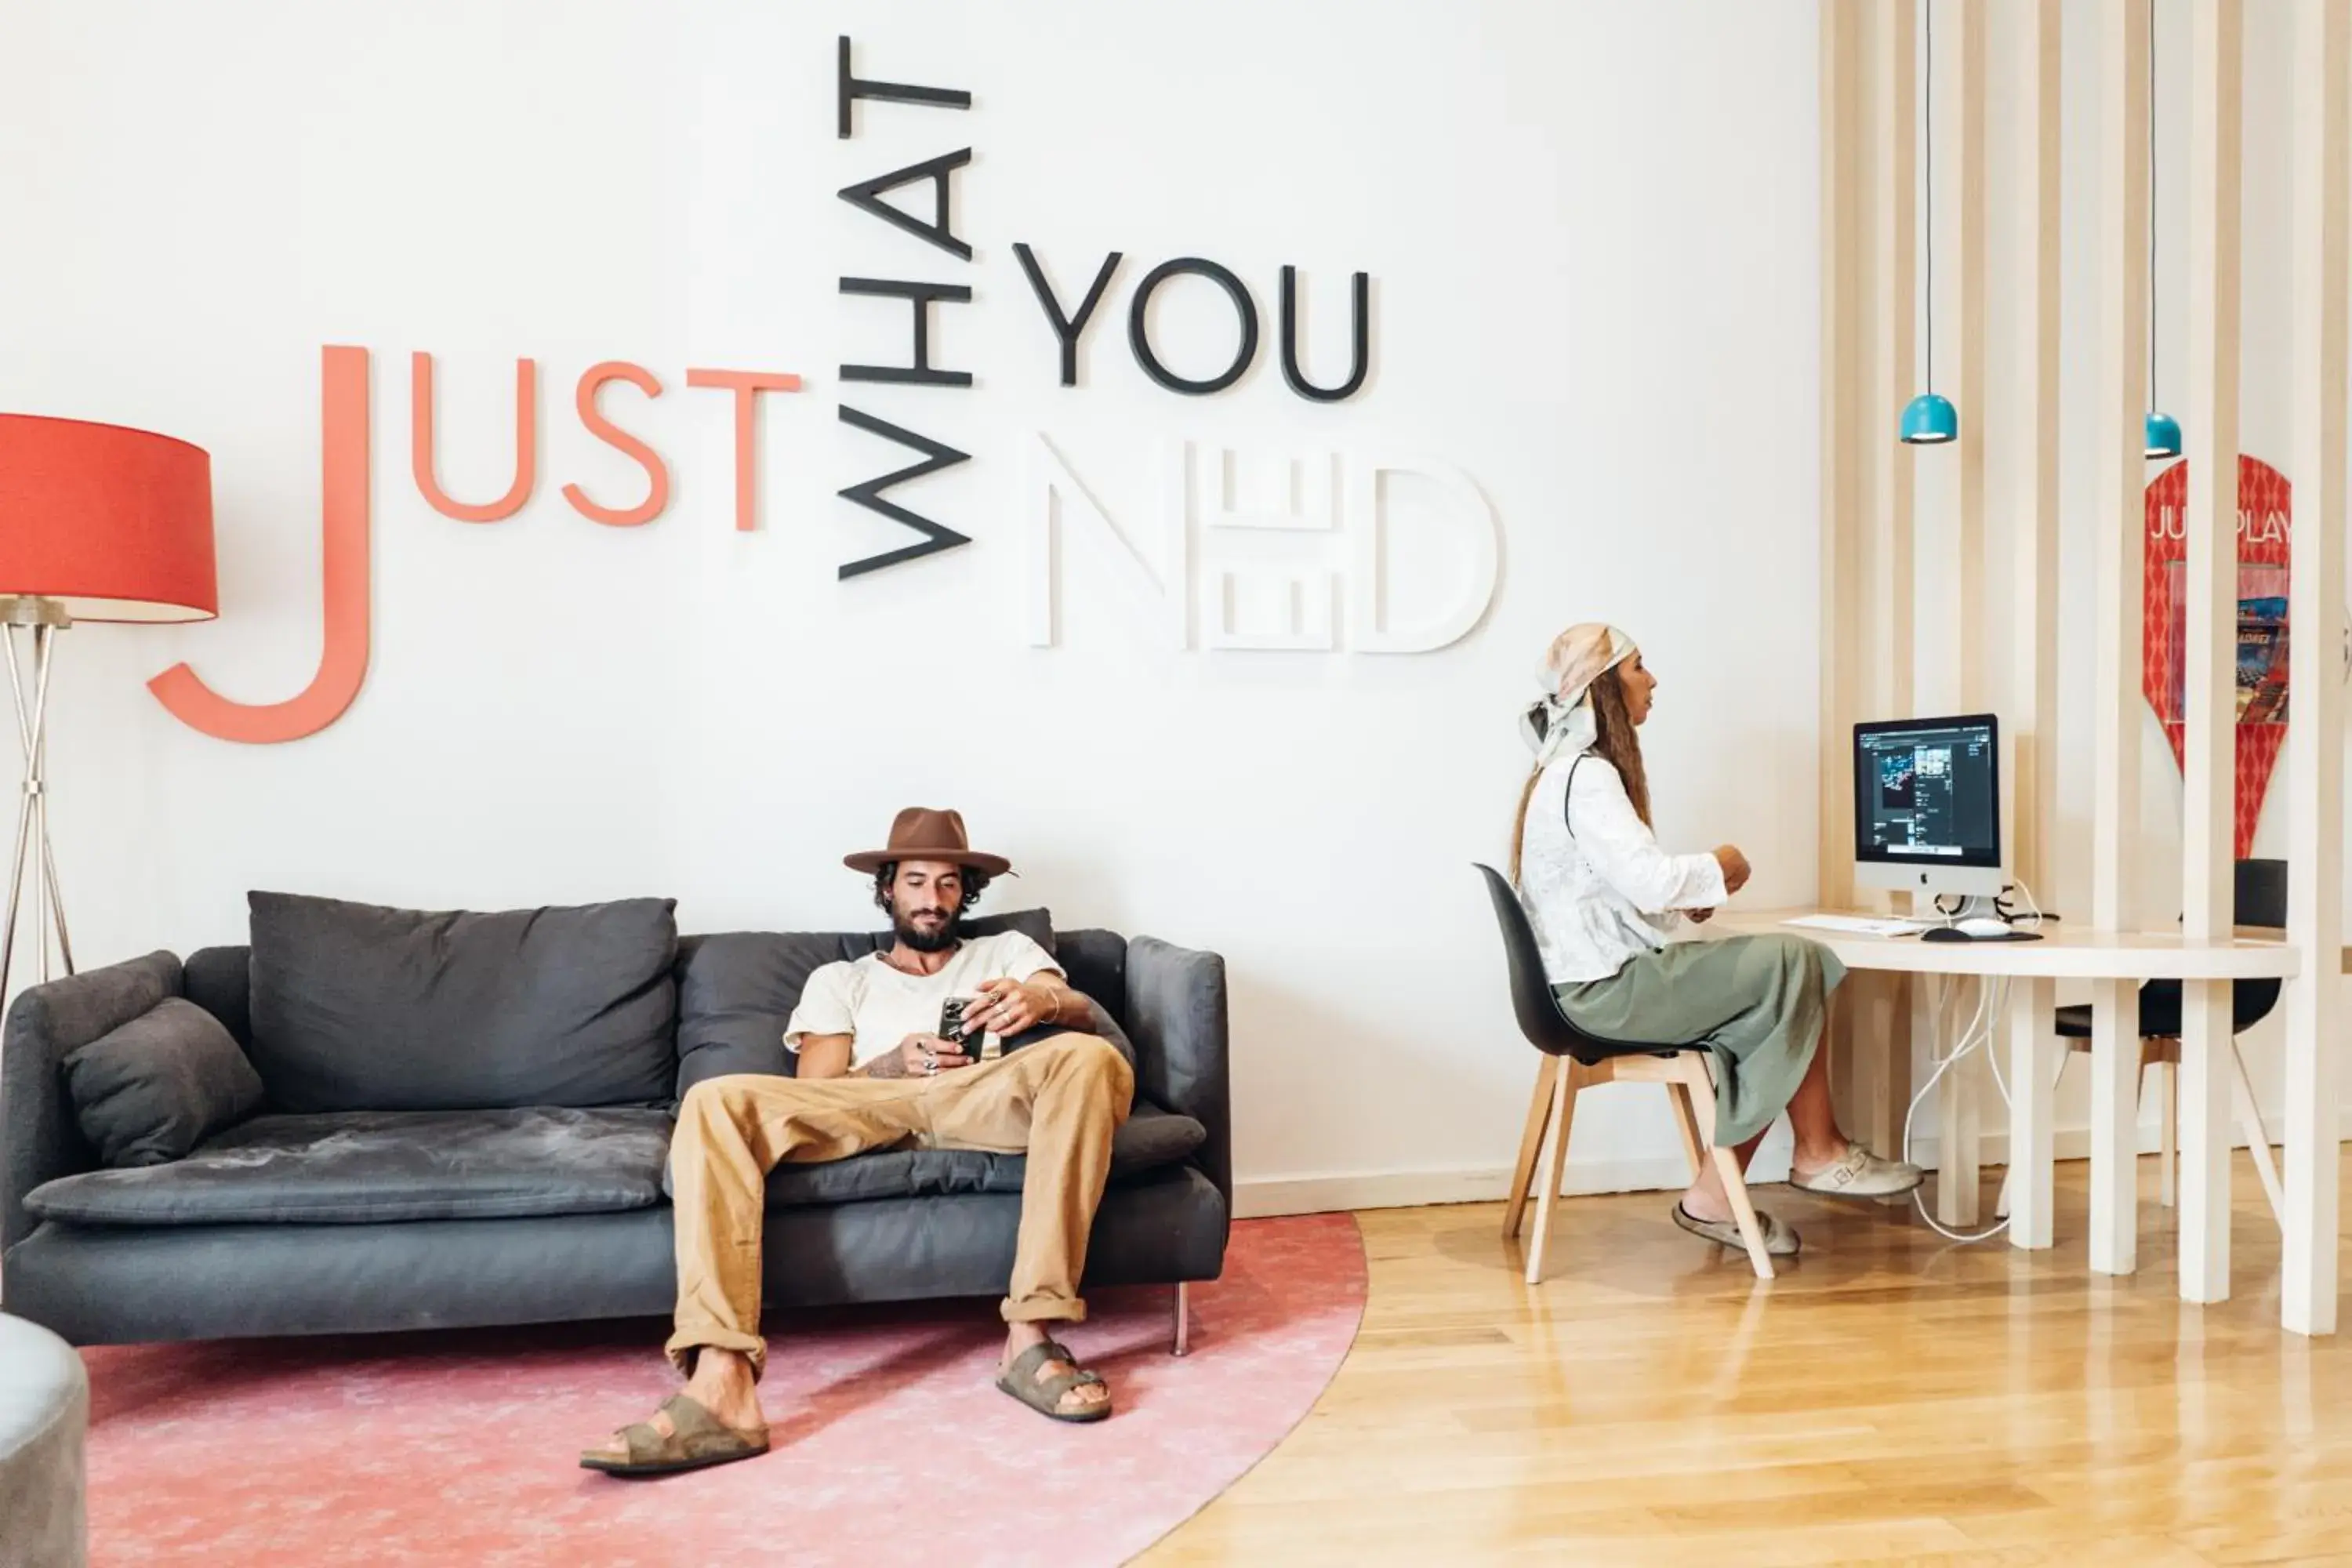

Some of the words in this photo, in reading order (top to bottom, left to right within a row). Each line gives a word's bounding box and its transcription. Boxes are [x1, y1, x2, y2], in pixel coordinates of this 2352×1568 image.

[838, 36, 973, 581] WHAT
[1012, 242, 1369, 404] YOU
[147, 346, 800, 743] JUST
[2151, 505, 2187, 539] JU
